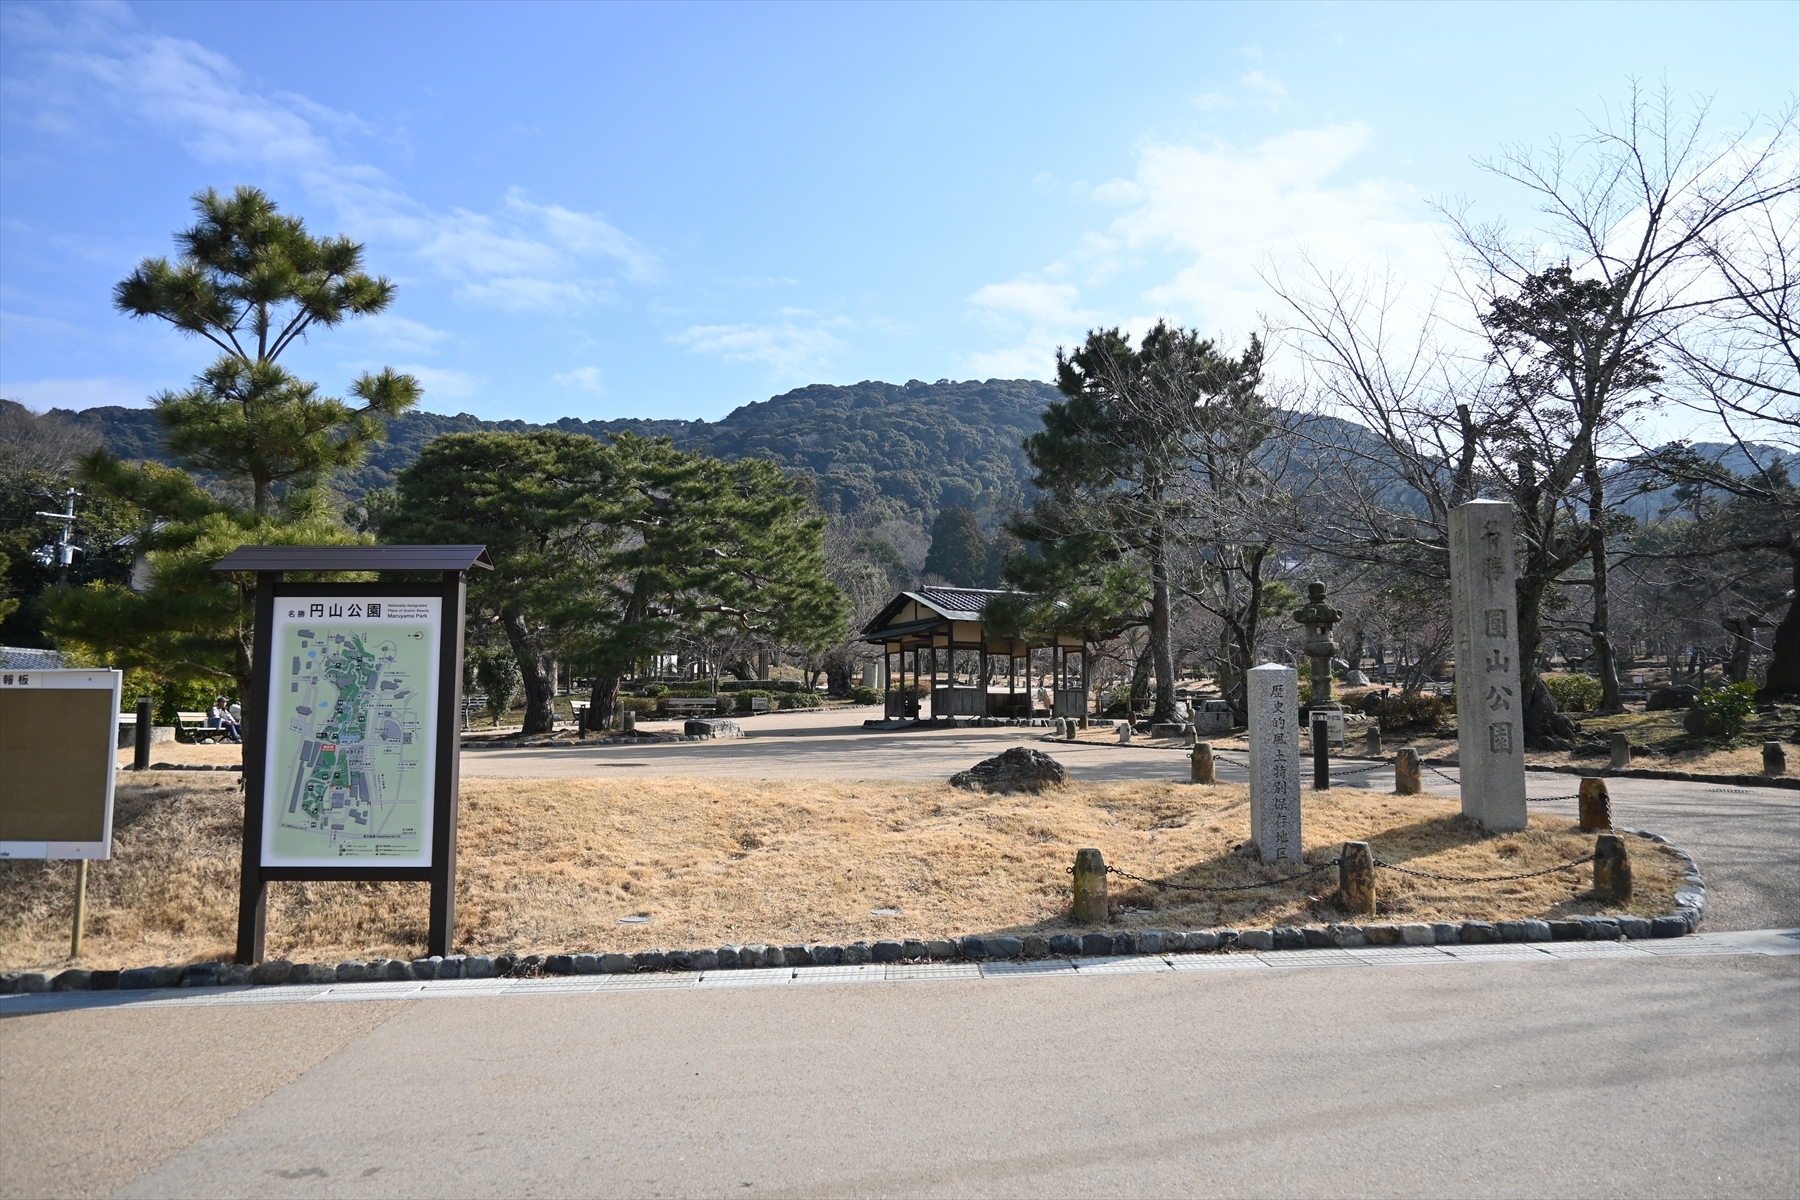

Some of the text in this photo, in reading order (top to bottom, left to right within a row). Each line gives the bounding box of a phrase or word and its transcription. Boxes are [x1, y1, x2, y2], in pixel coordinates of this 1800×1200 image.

[288, 603, 381, 618] 名勝 円山公園
[2, 674, 29, 685] 報板
[1269, 684, 1289, 860] 歴史的風土特別保存地区
